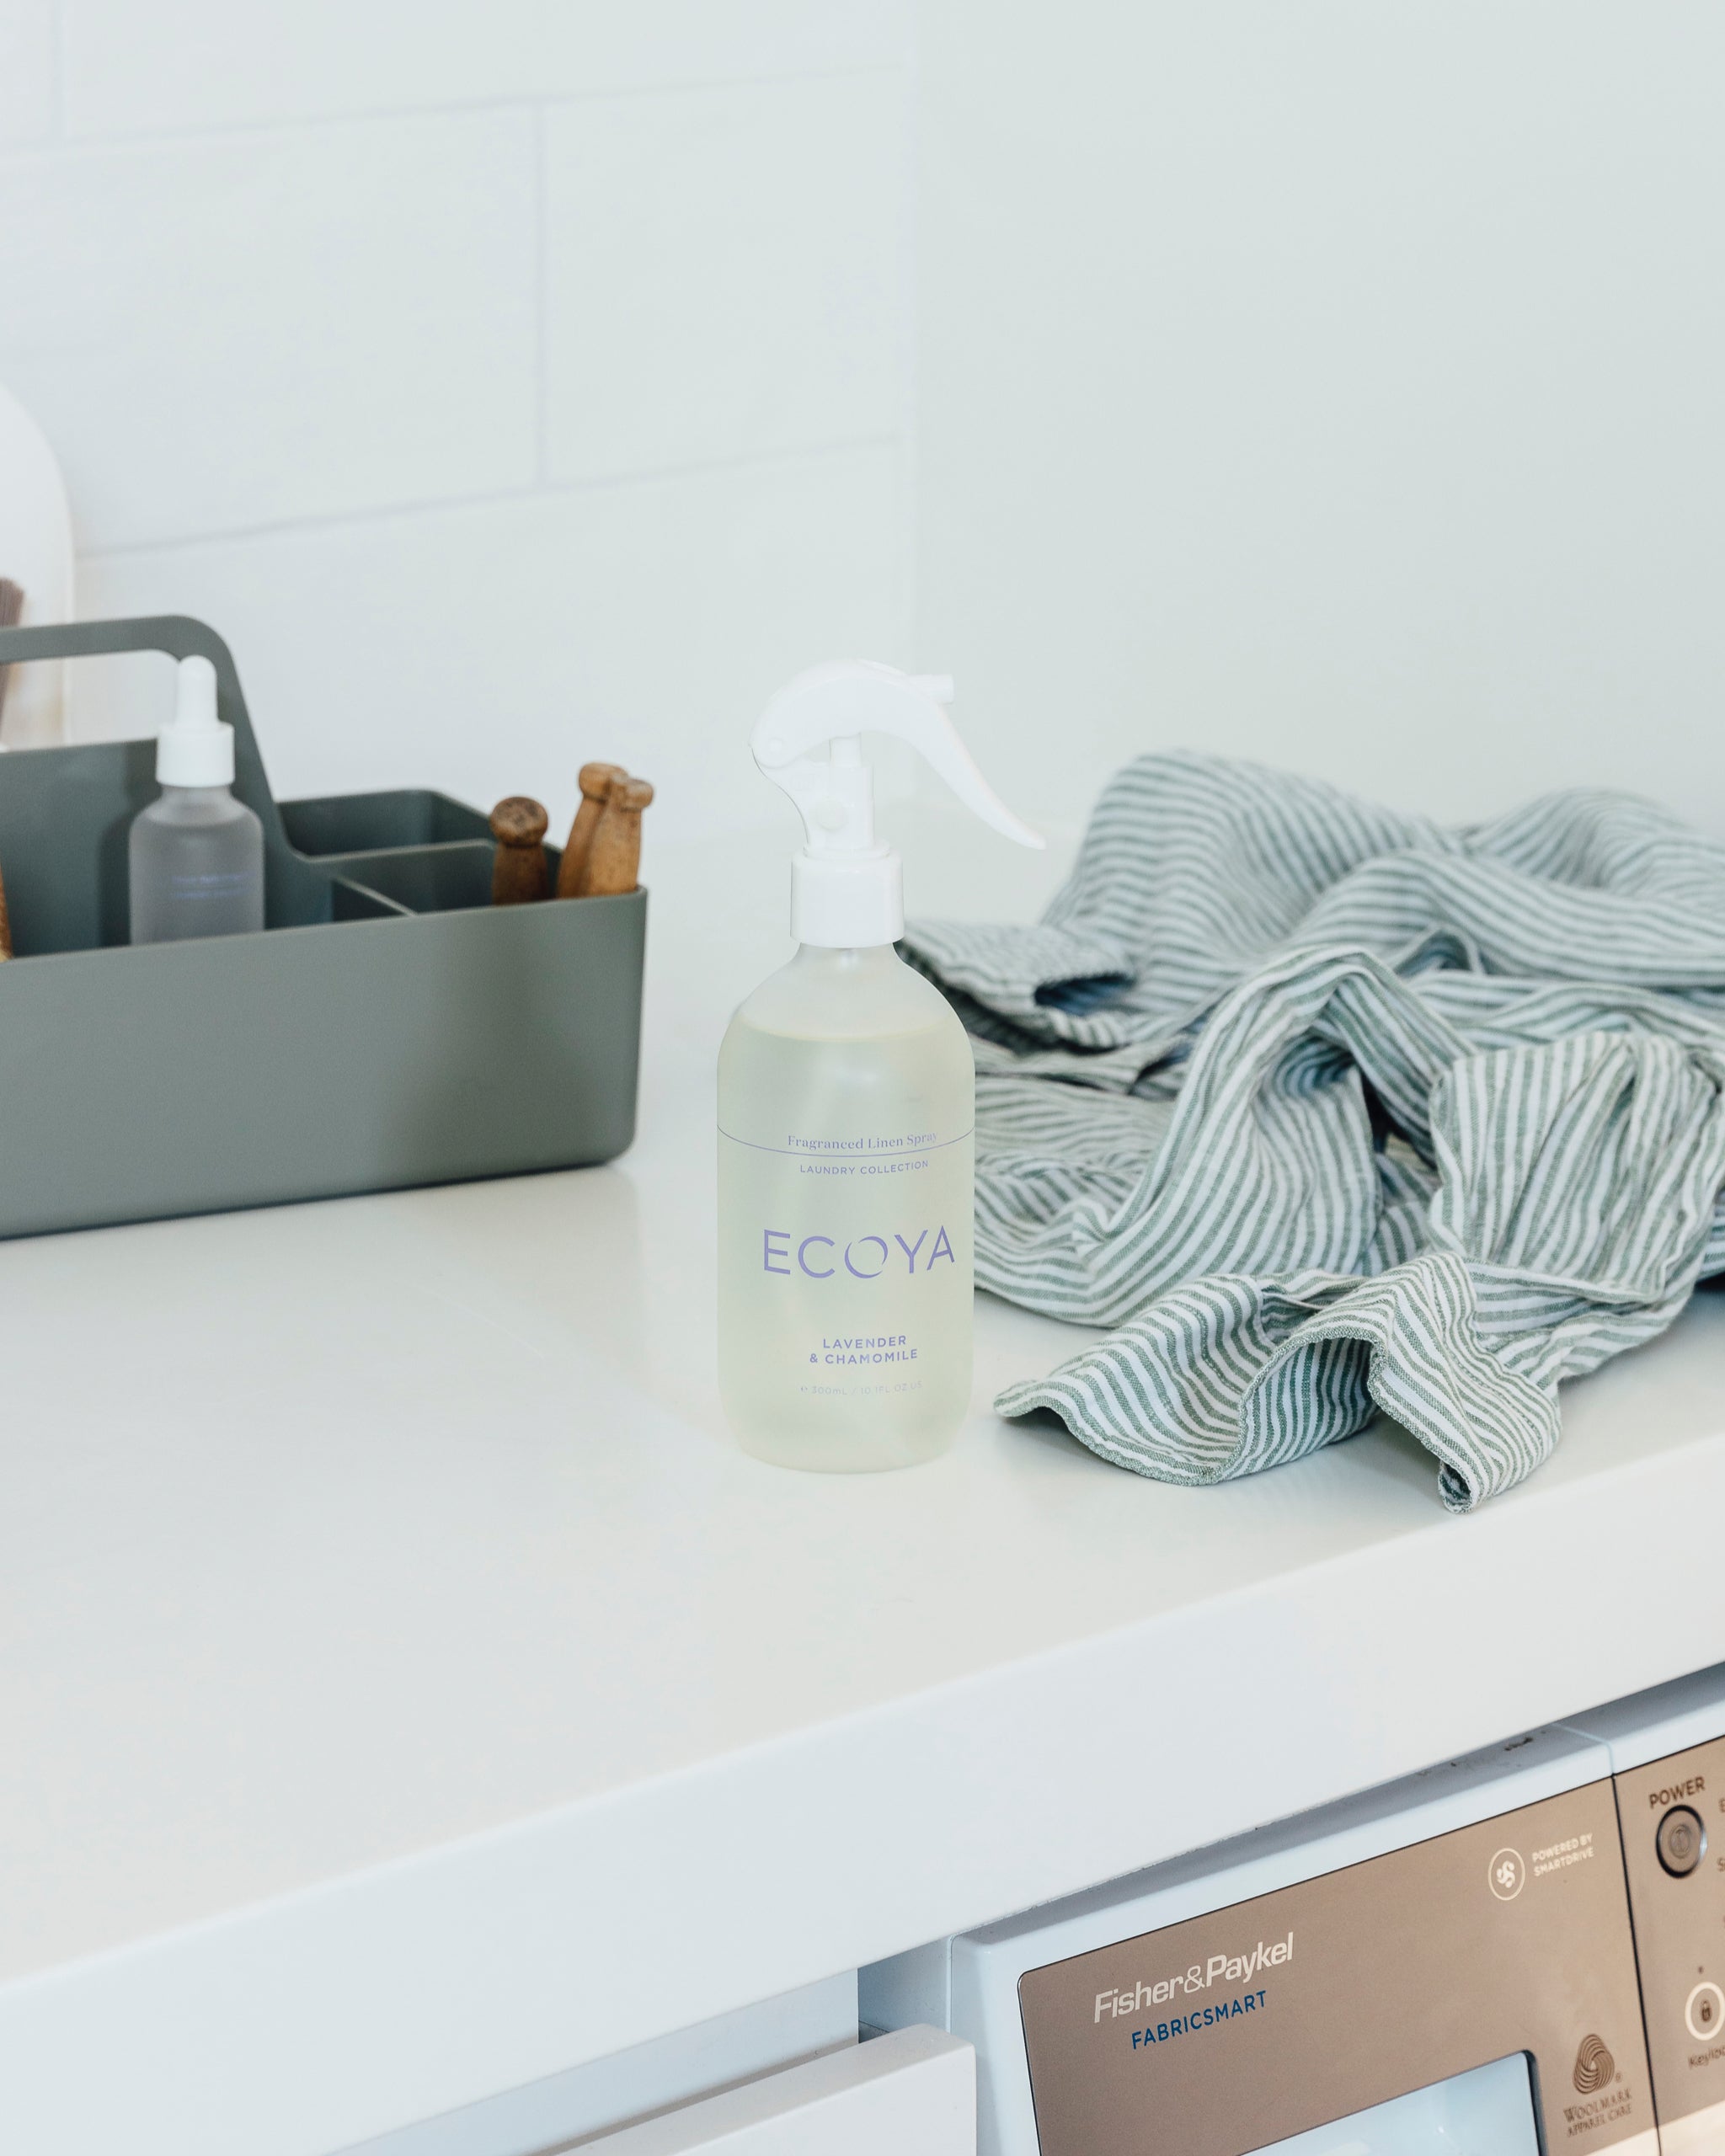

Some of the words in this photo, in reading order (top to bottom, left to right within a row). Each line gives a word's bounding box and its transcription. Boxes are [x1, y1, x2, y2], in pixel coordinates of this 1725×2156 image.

[788, 1134, 863, 1150] Fragranced
[868, 1137, 903, 1149] Linen
[906, 1131, 937, 1146] Spray
[800, 1165, 855, 1175] LAUNDRY
[860, 1160, 929, 1175] COLLECTION
[763, 1225, 955, 1279] ECOYA
[809, 1353, 819, 1364] &
[825, 1348, 918, 1364] CHAMOMILE
[823, 1335, 906, 1348] LAVENDER
[1648, 1775, 1706, 1810] POWER
[1531, 1838, 1579, 1863] POWERED
[1579, 1832, 1593, 1846] BY
[1533, 1845, 1594, 1877] SMARTDRIVE
[1131, 1989, 1267, 2050] FABRICSMART
[1563, 2088, 1632, 2122] WOOLMARK
